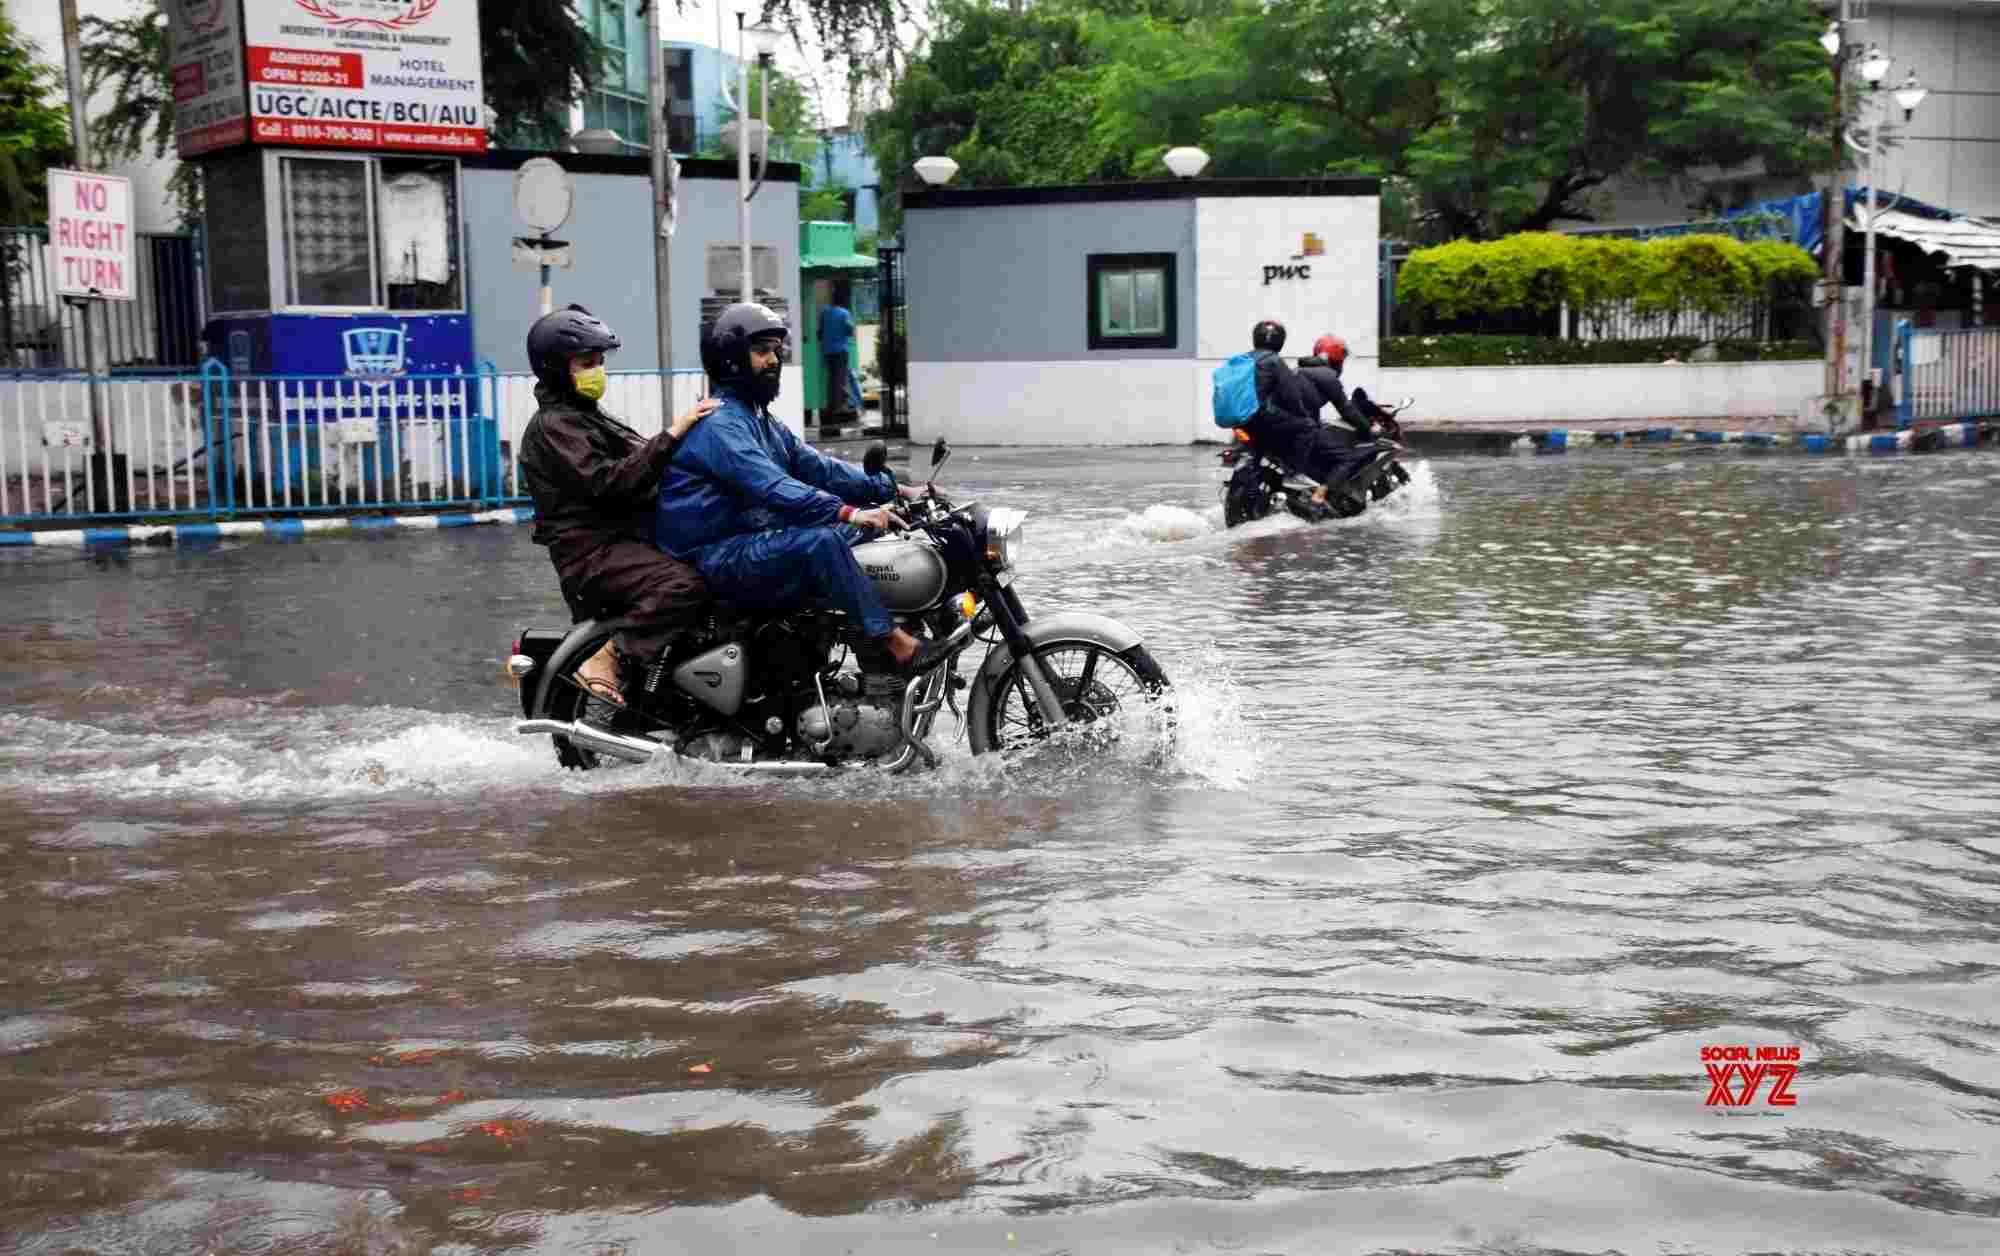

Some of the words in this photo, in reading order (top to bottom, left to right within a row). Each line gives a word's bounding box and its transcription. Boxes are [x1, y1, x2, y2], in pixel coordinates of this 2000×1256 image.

[269, 51, 340, 67] ADMISSION
[400, 59, 446, 73] HOTEL
[262, 67, 298, 81] OPEN
[371, 74, 475, 91] MANAGEMENT
[257, 94, 477, 126] UGC/AICTE/BCI/AIU
[257, 122, 282, 136] Call
[75, 182, 107, 213] NO
[59, 217, 127, 252] RIGHT
[63, 256, 122, 290] TURN
[1263, 265, 1311, 286] pwc
